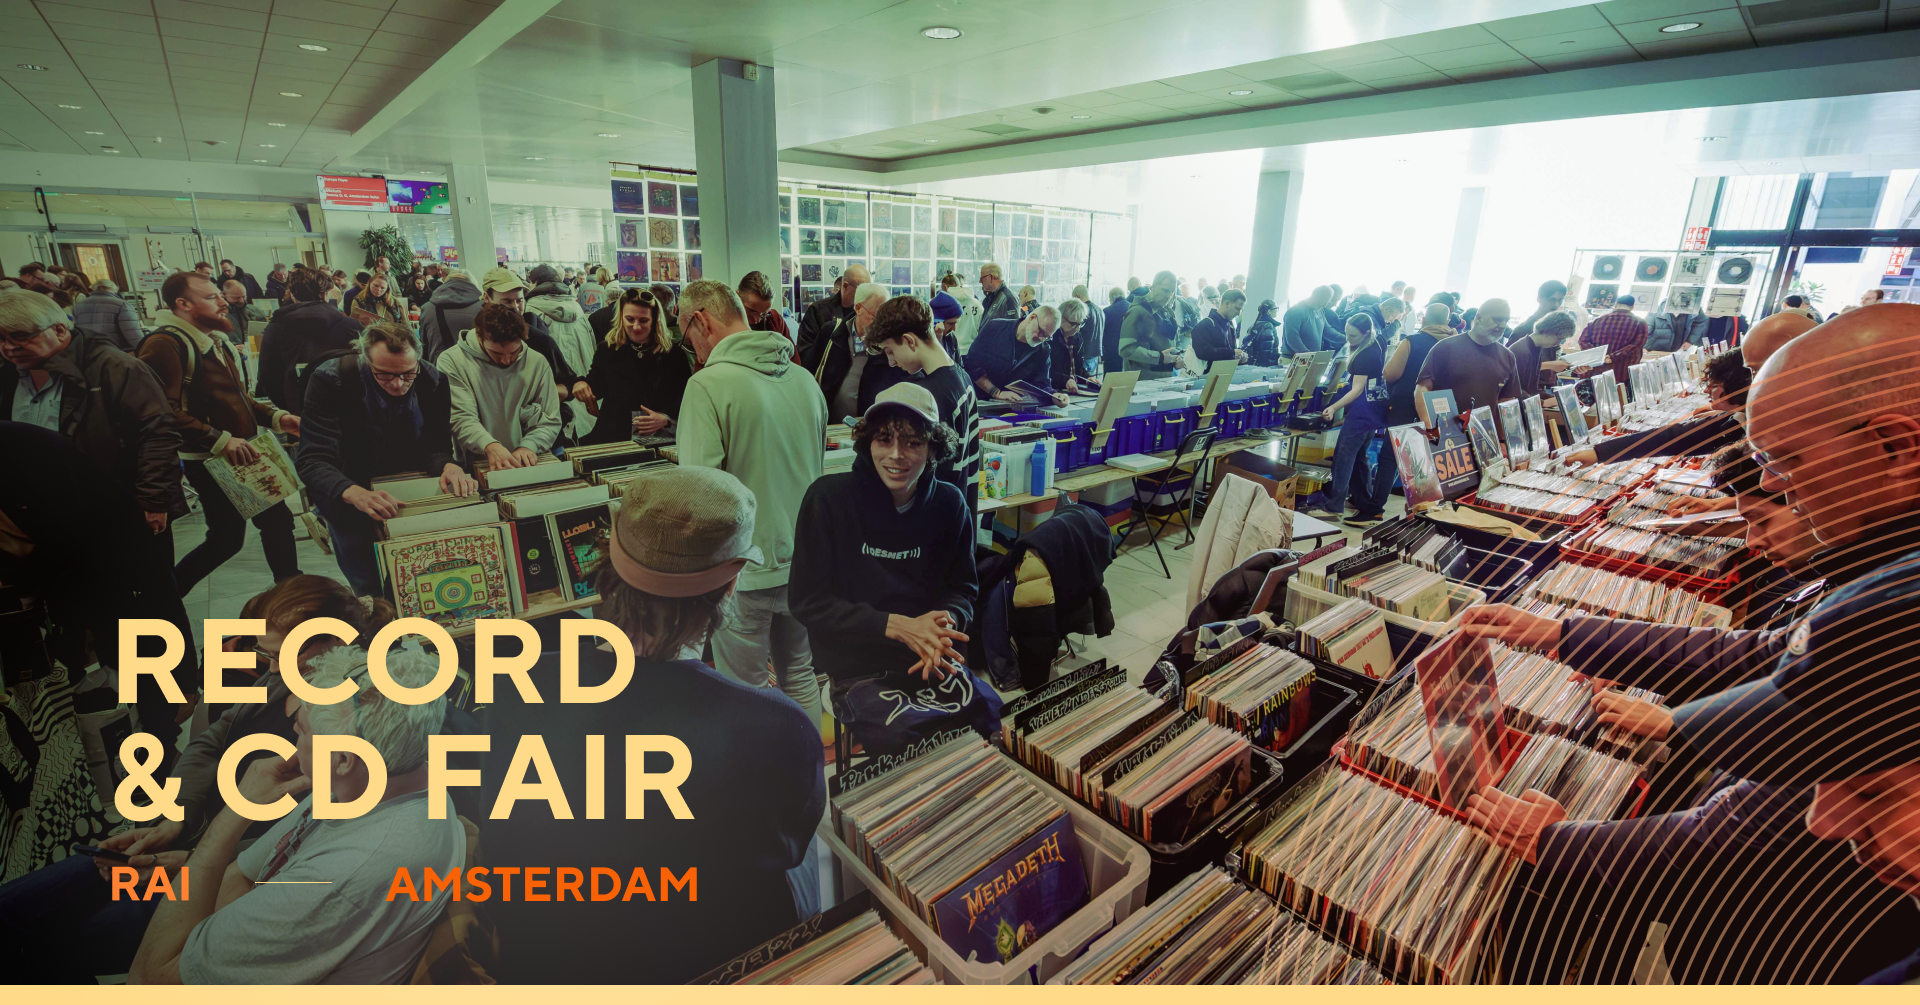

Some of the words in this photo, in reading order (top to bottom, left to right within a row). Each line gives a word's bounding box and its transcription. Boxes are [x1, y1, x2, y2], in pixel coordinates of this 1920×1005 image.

[1435, 446, 1474, 481] SALE
[390, 541, 439, 557] GEORGE
[1262, 671, 1317, 716] RAINBOWS
[960, 831, 1066, 934] MEGADETH
